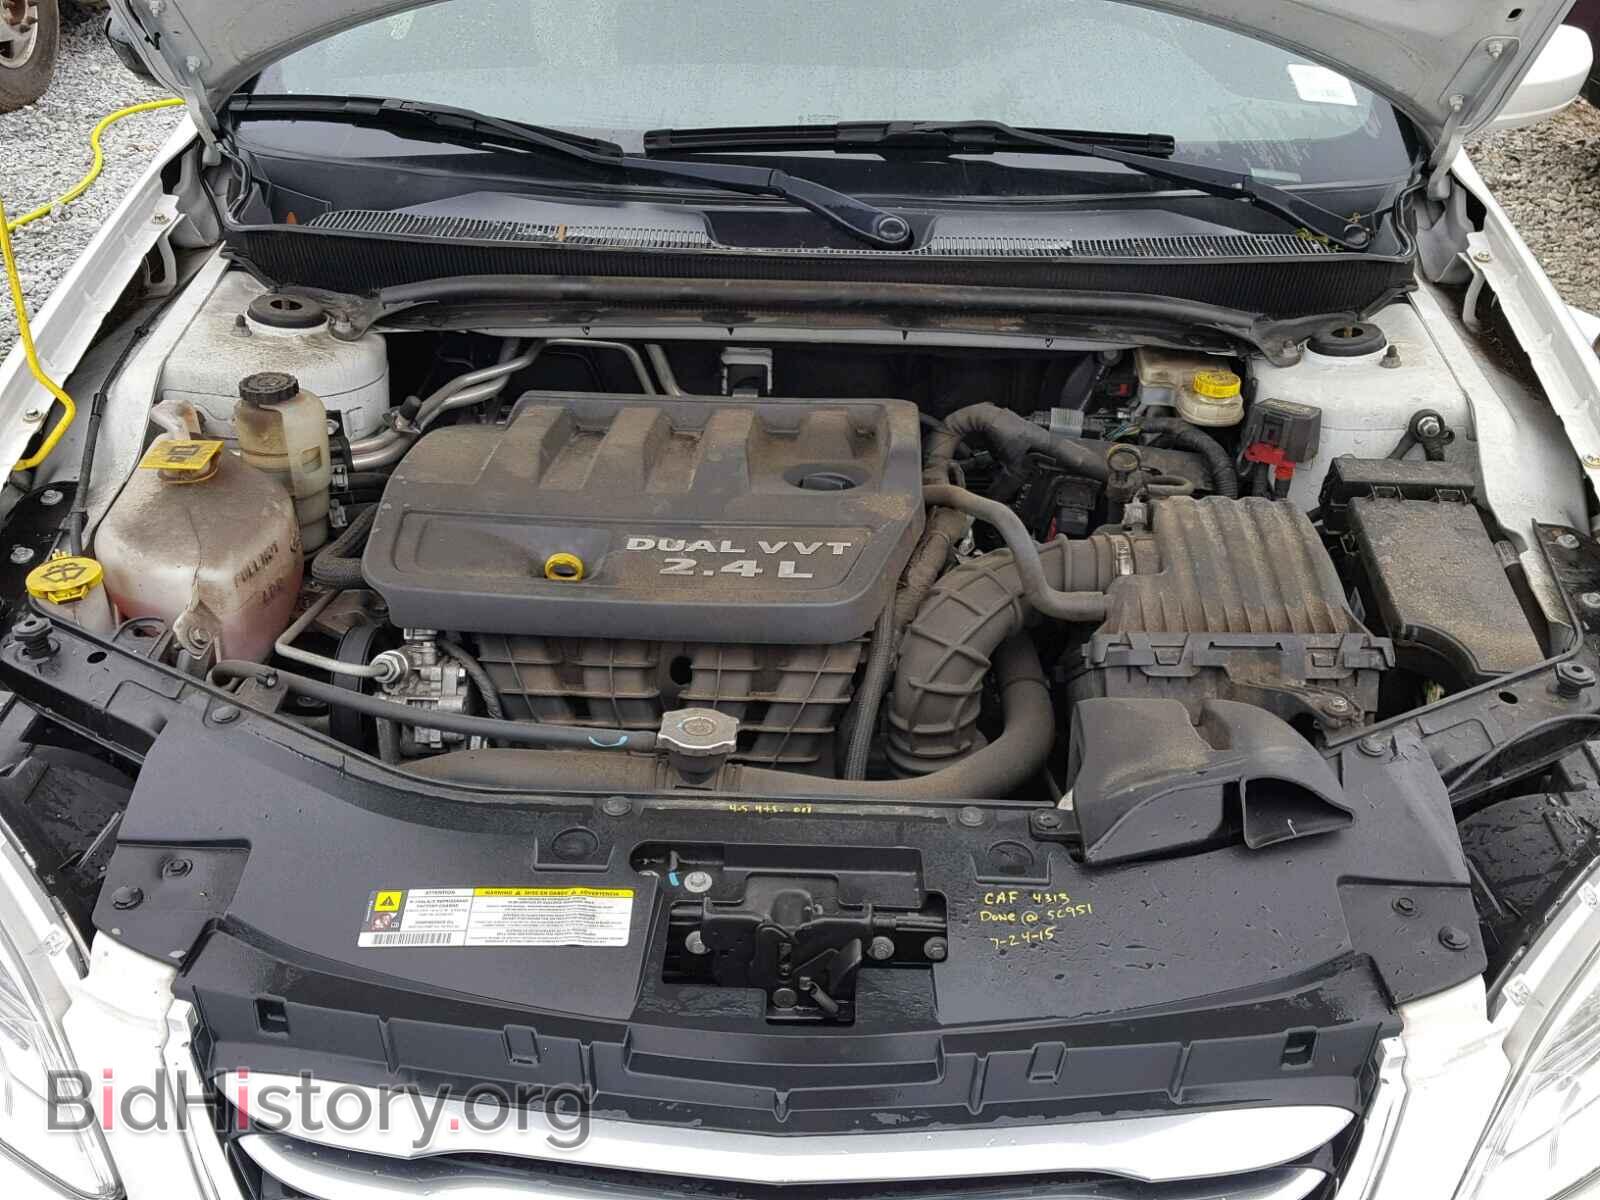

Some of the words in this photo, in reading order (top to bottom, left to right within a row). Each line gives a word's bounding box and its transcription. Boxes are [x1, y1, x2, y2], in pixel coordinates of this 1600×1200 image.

[625, 537, 746, 553] DUAL
[758, 541, 852, 556] VVT
[984, 891, 1019, 905] CAF
[989, 926, 1058, 950] 7-24-15
